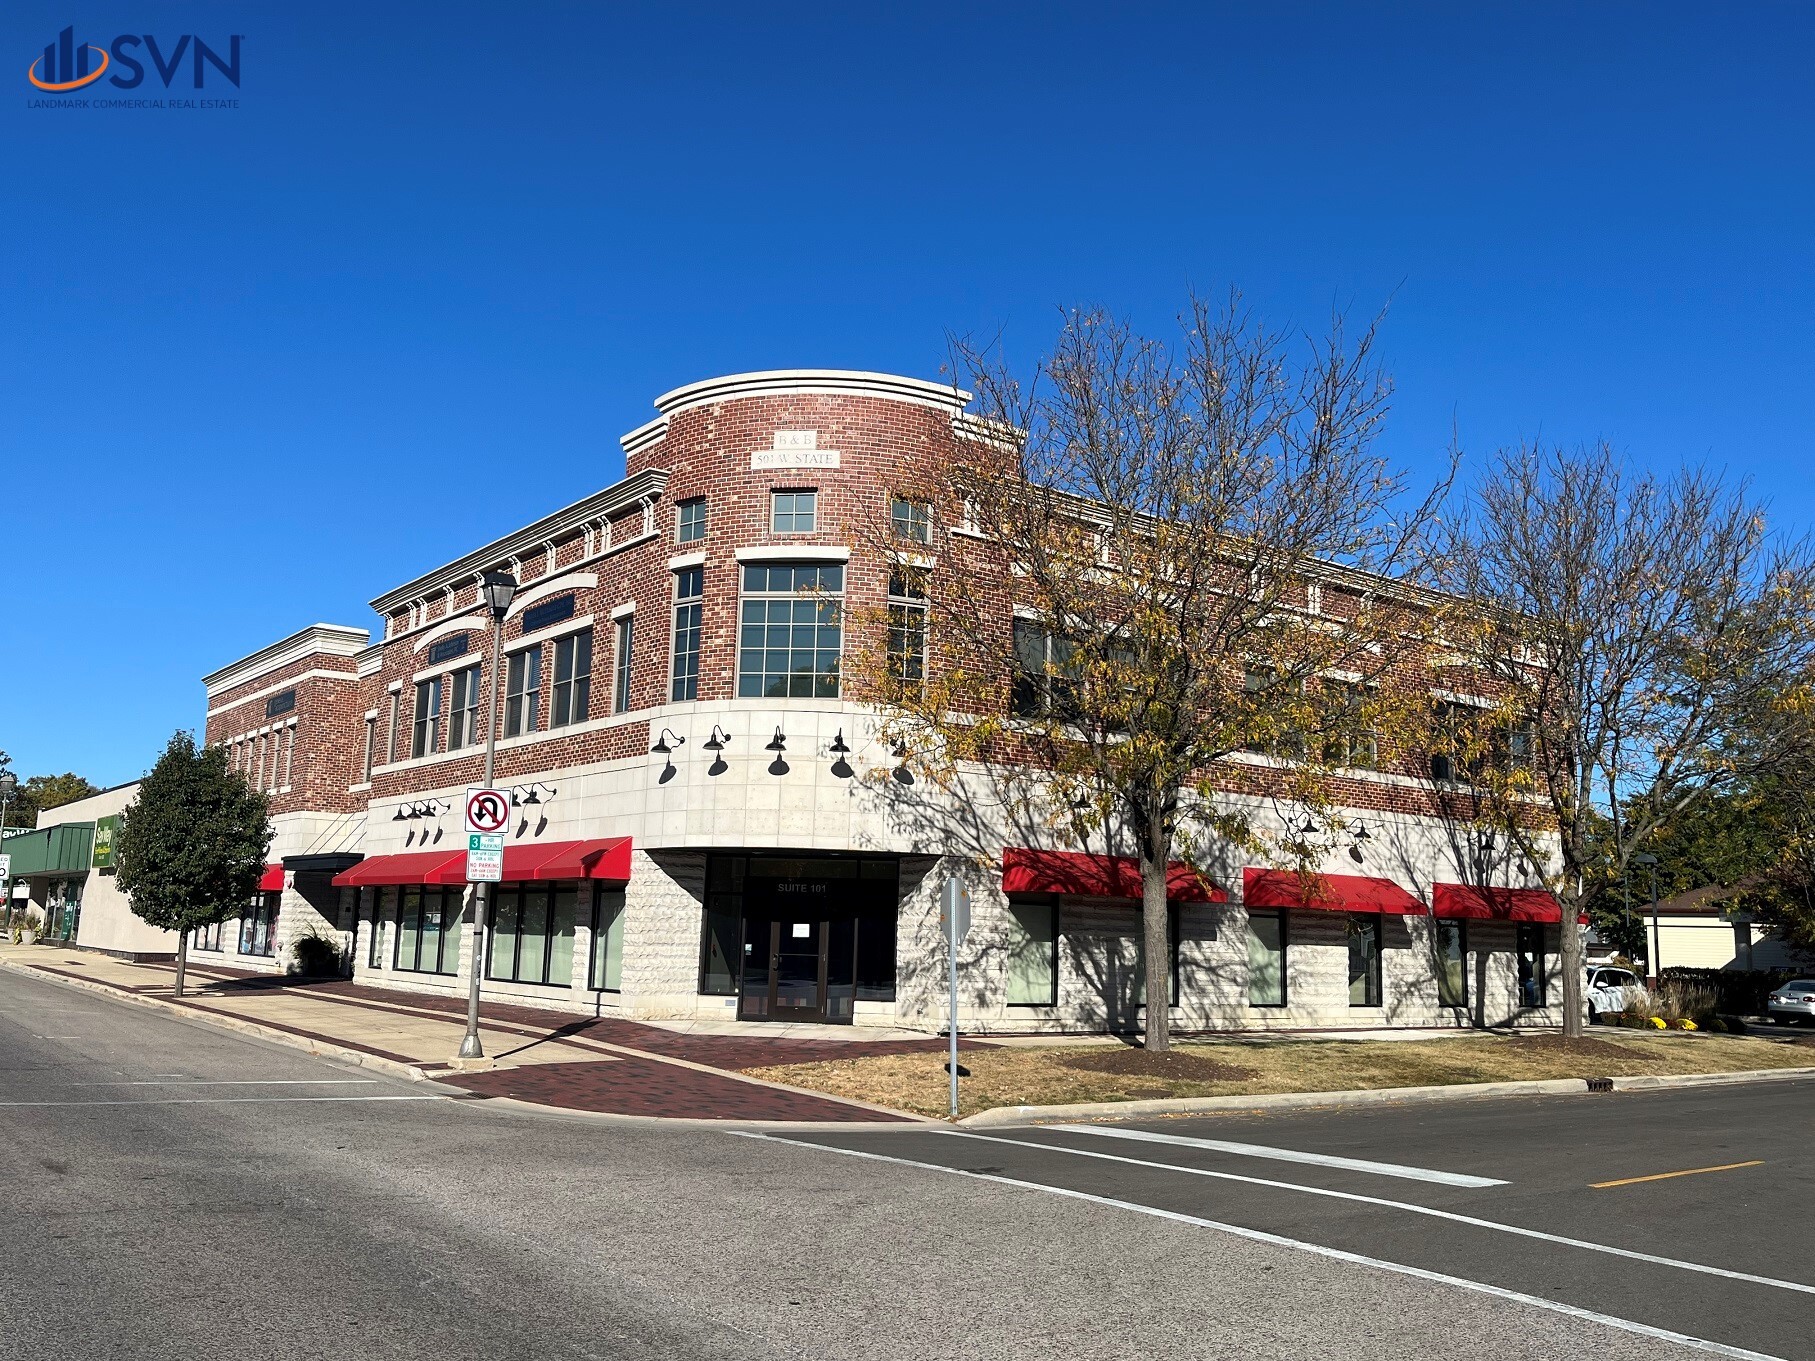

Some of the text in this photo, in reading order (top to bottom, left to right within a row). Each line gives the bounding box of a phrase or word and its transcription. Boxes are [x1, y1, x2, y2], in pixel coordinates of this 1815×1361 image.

[790, 434, 799, 445] &
[795, 453, 833, 464] STATE
[471, 837, 479, 848] 3
[777, 883, 826, 893] SUITE 101
